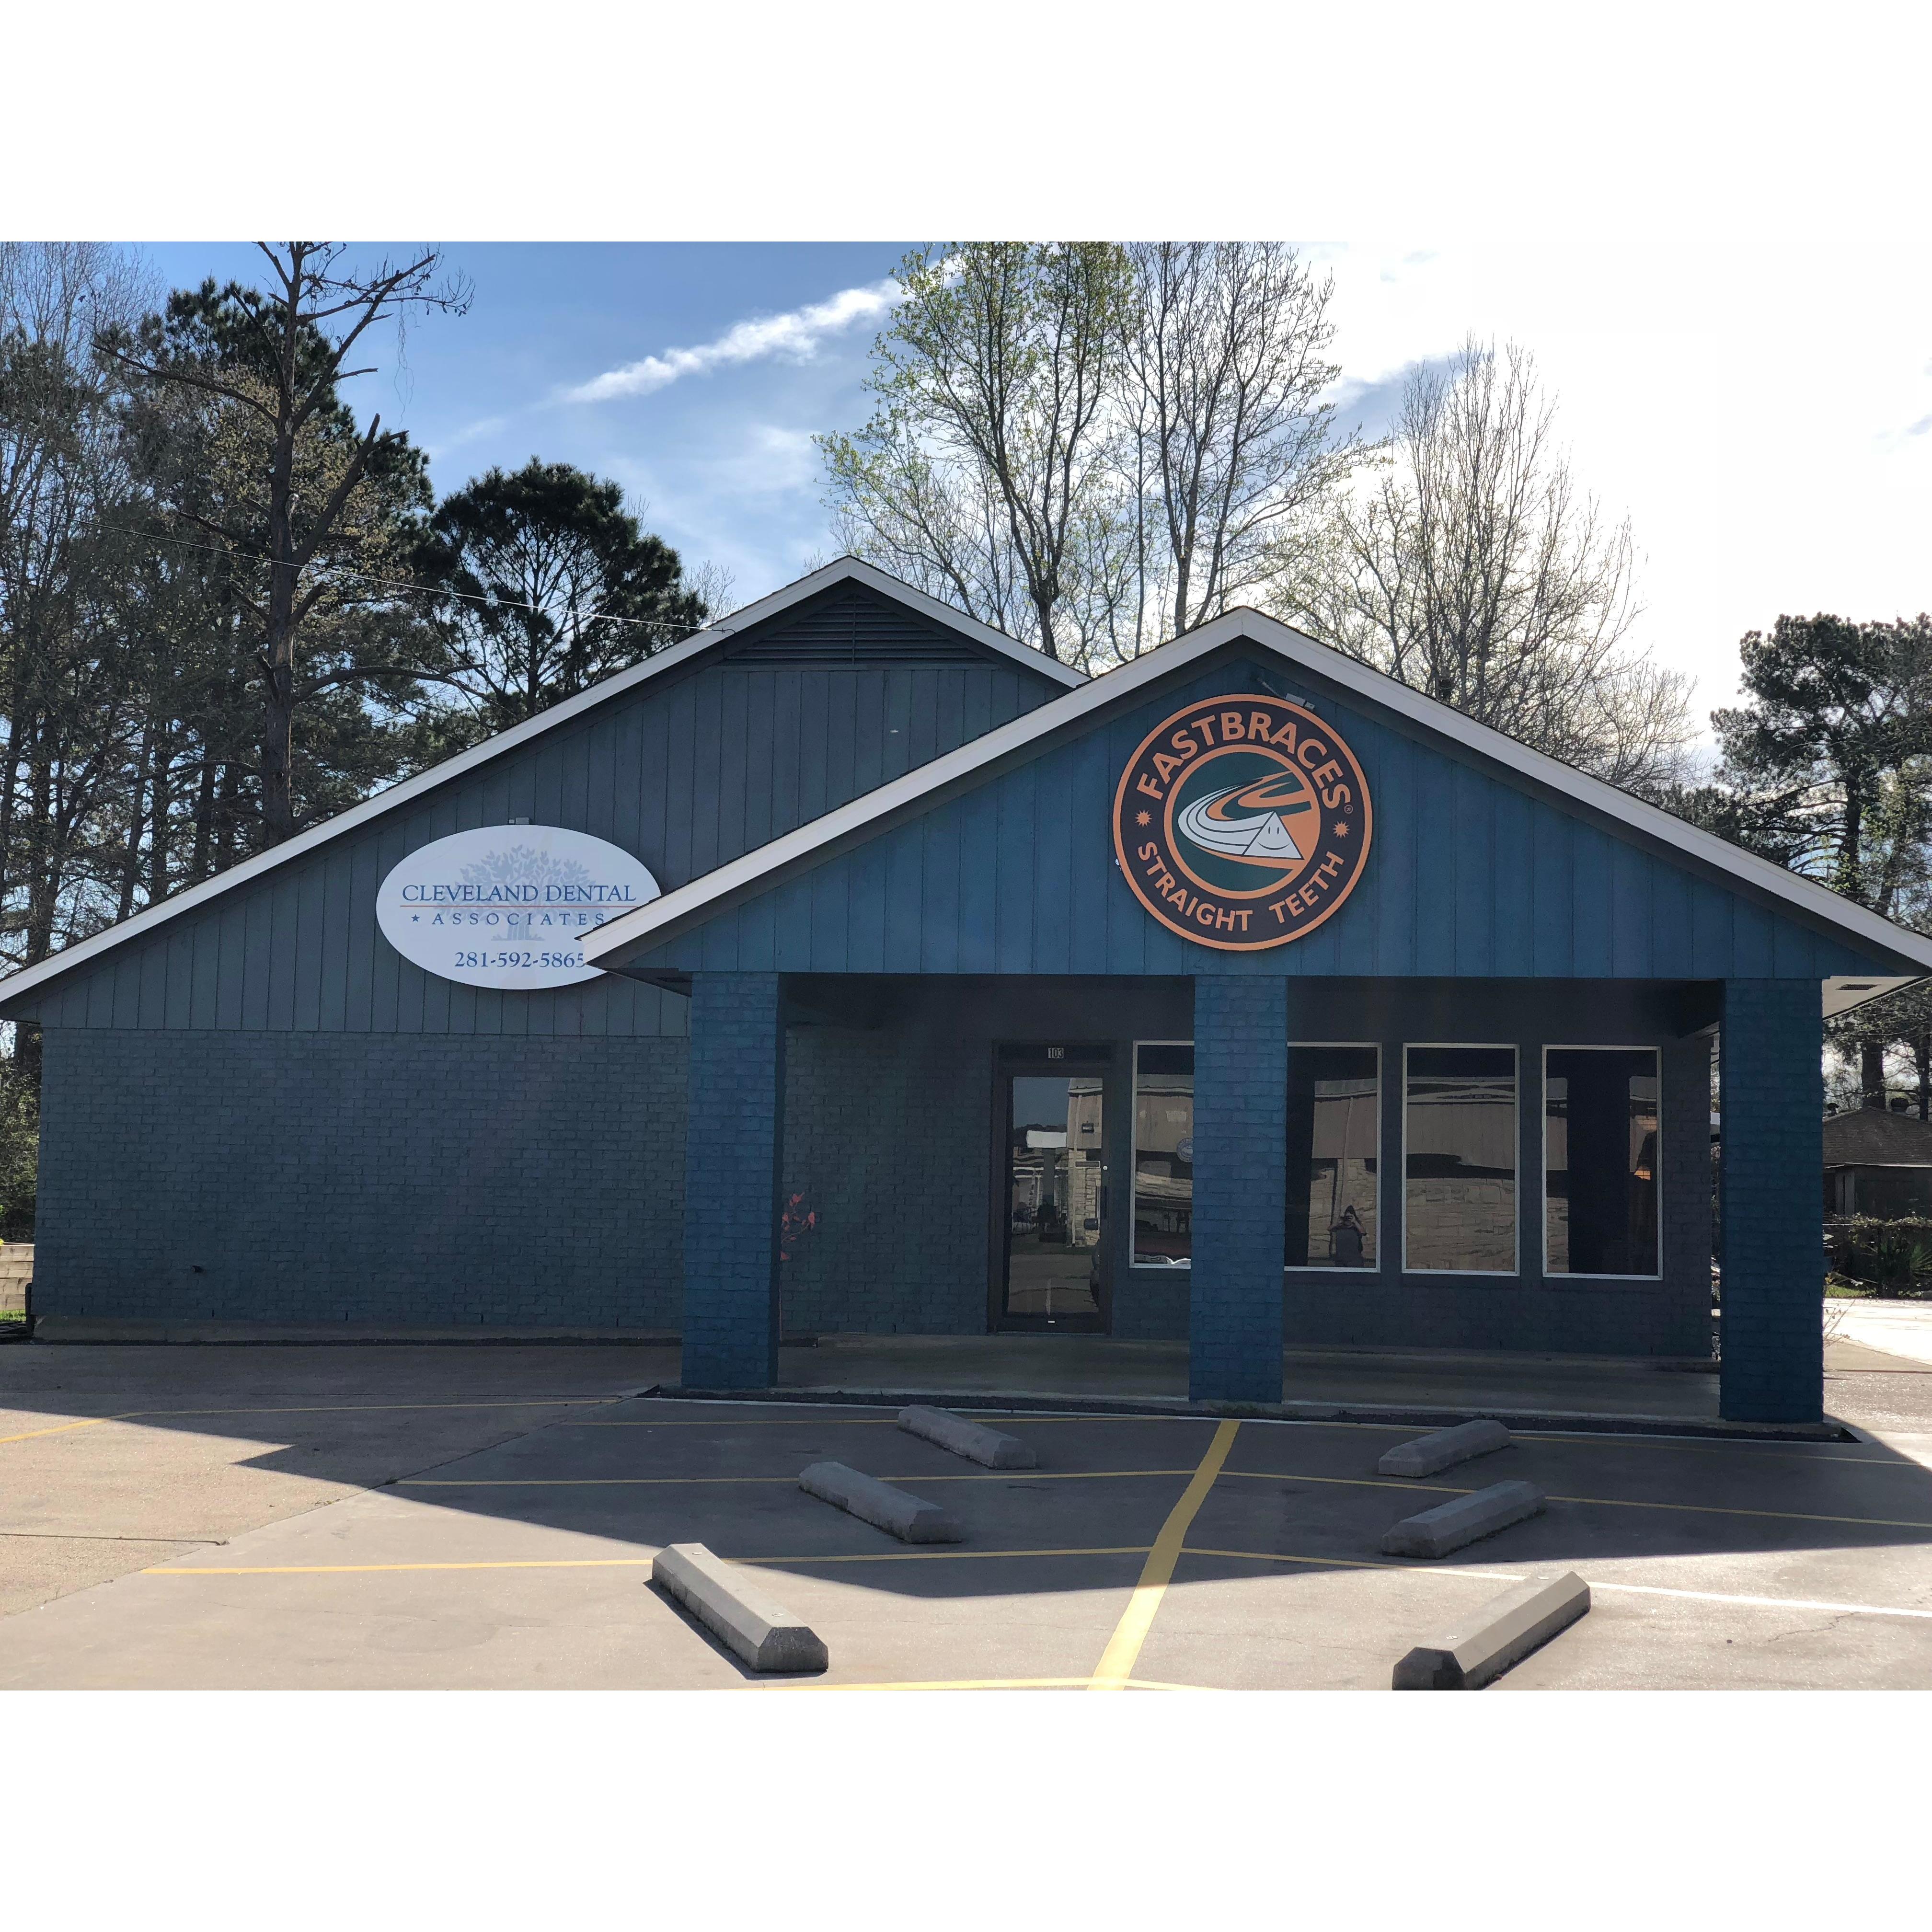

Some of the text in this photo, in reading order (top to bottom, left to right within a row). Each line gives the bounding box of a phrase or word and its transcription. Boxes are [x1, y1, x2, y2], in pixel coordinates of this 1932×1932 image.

[402, 885, 636, 902] CLEVELAND DENTAL
[1138, 842, 1344, 931] STRAIGHT TEETH
[432, 913, 604, 925] ASSOCIATES
[454, 952, 585, 968] 281-592-5865
[1049, 1048, 1063, 1058] 103
